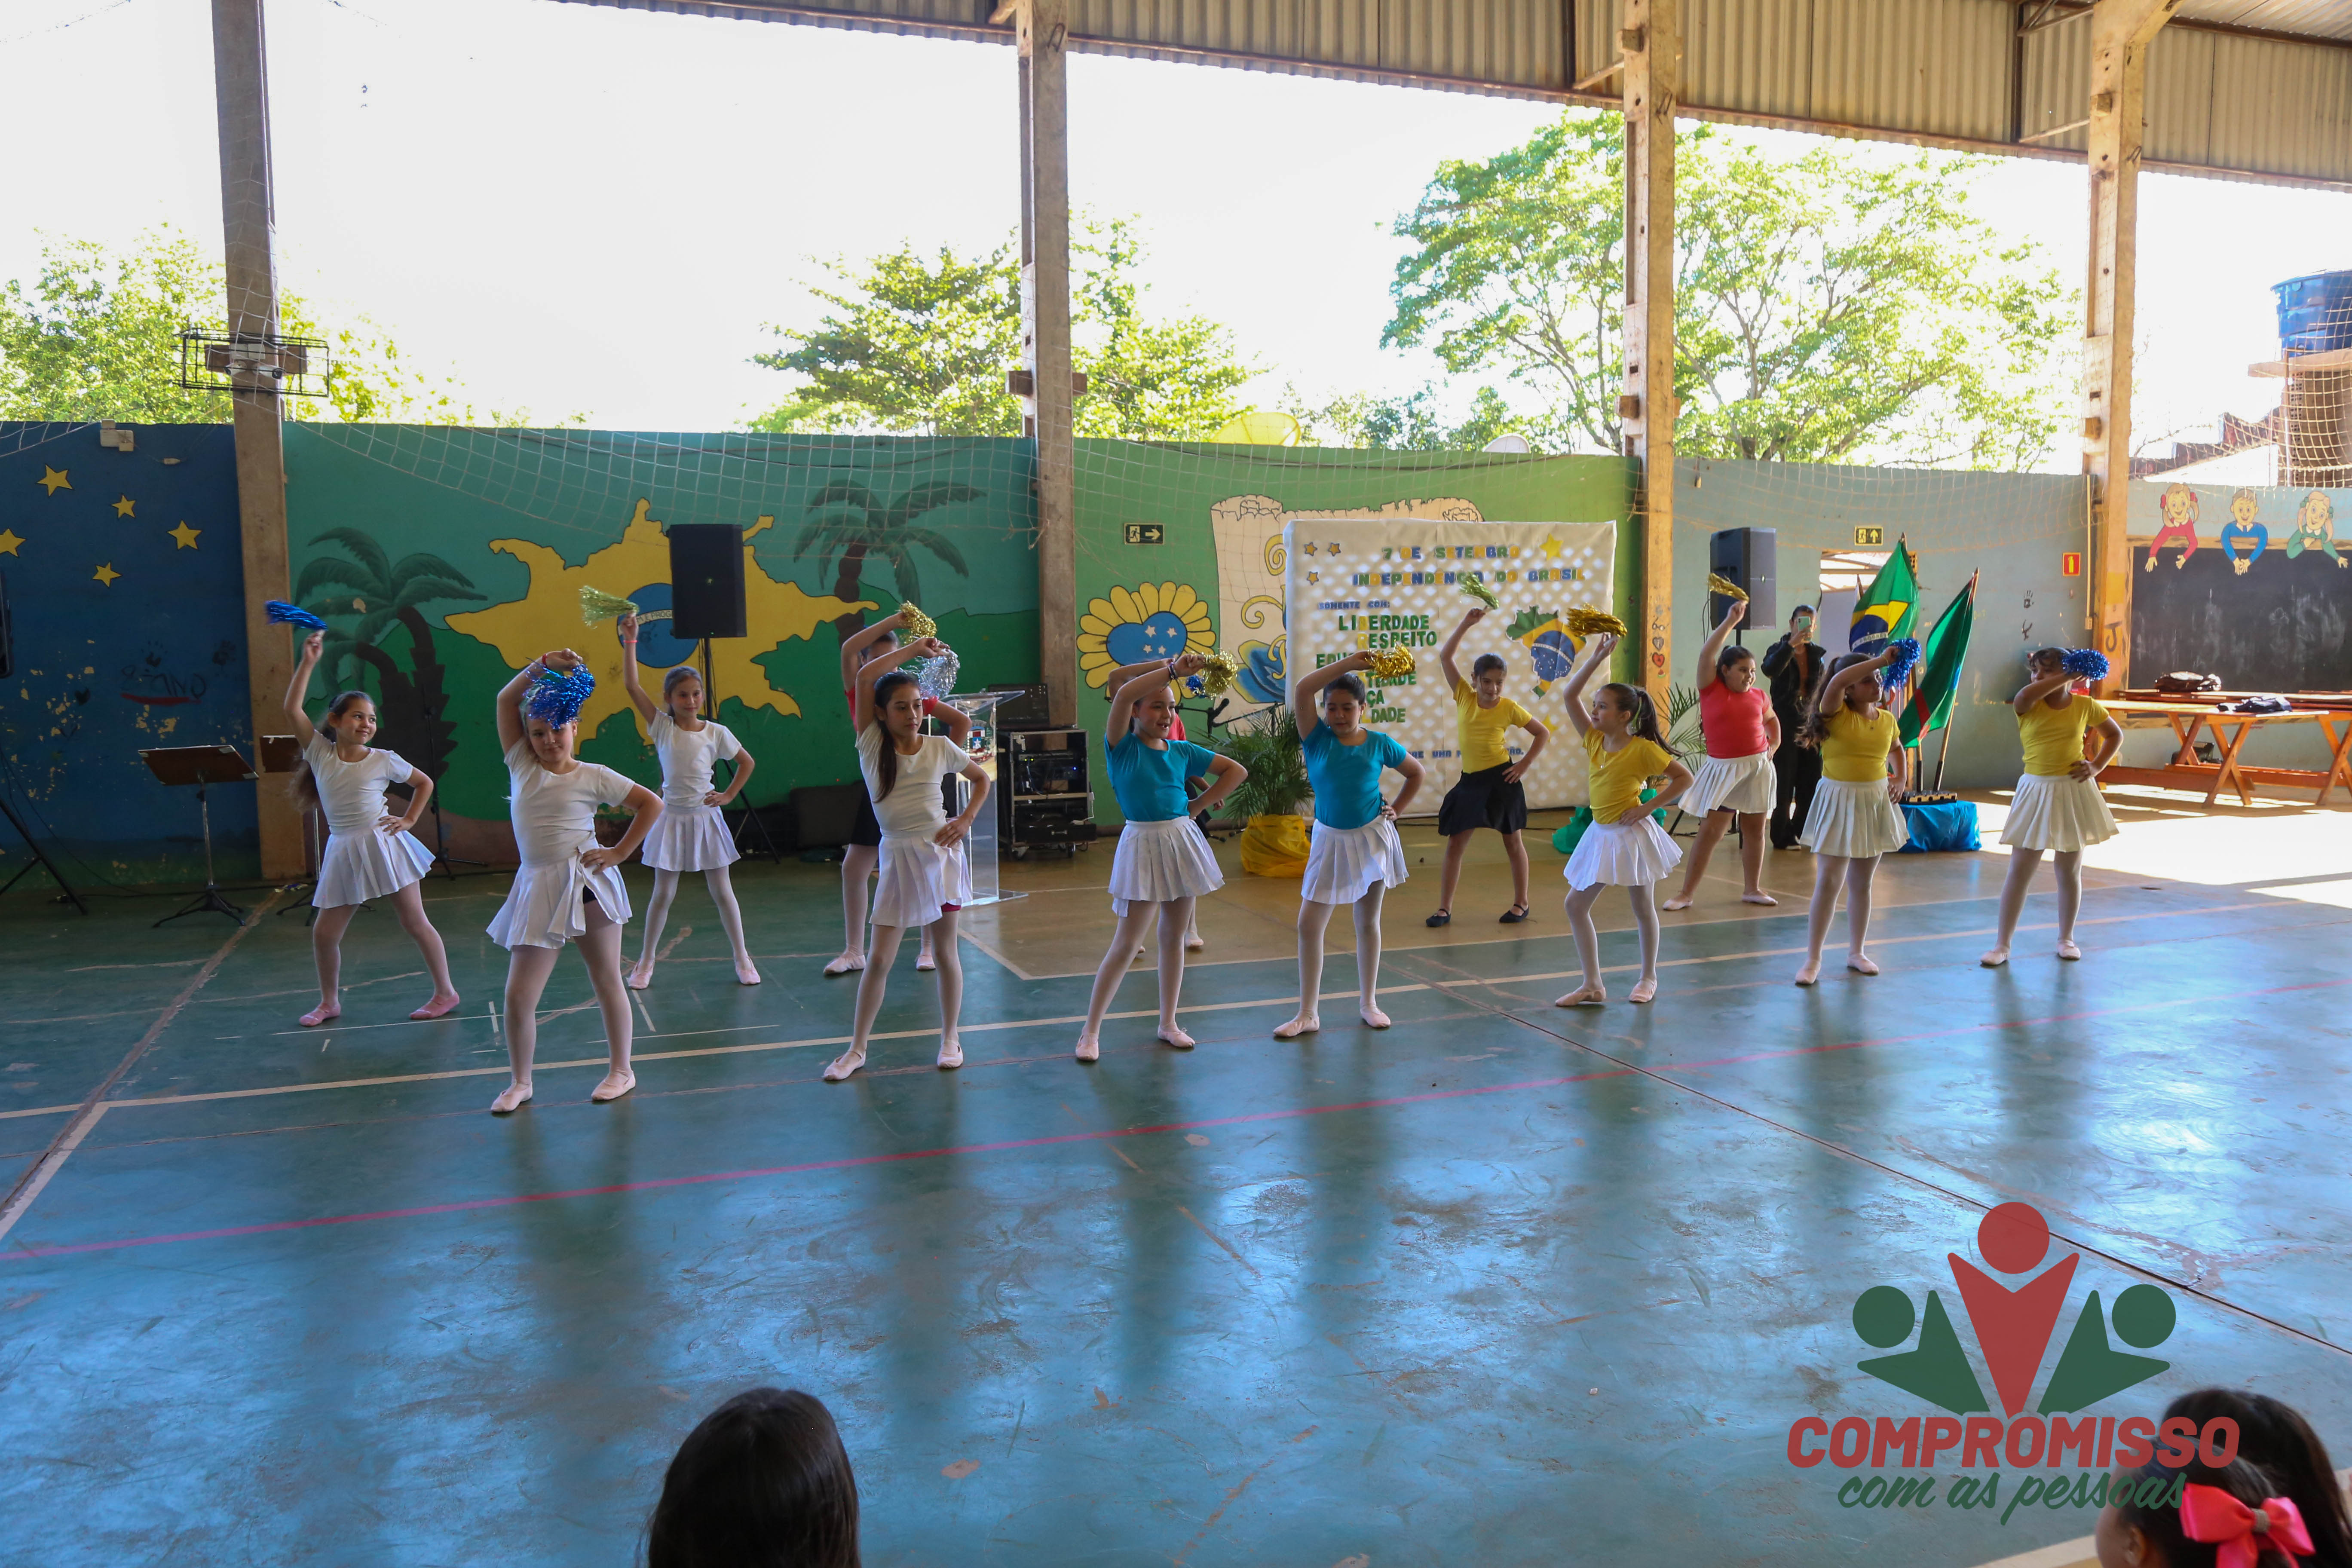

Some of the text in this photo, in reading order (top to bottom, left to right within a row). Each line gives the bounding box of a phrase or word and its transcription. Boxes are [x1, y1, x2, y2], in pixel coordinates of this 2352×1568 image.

[1383, 545, 1520, 559] 7 DE SETEMBRO
[1353, 567, 1584, 585] INDEPENDÊNCA DO BRASIL
[1339, 615, 1429, 631] LIBERDADE
[1357, 631, 1437, 649] RESPEITO
